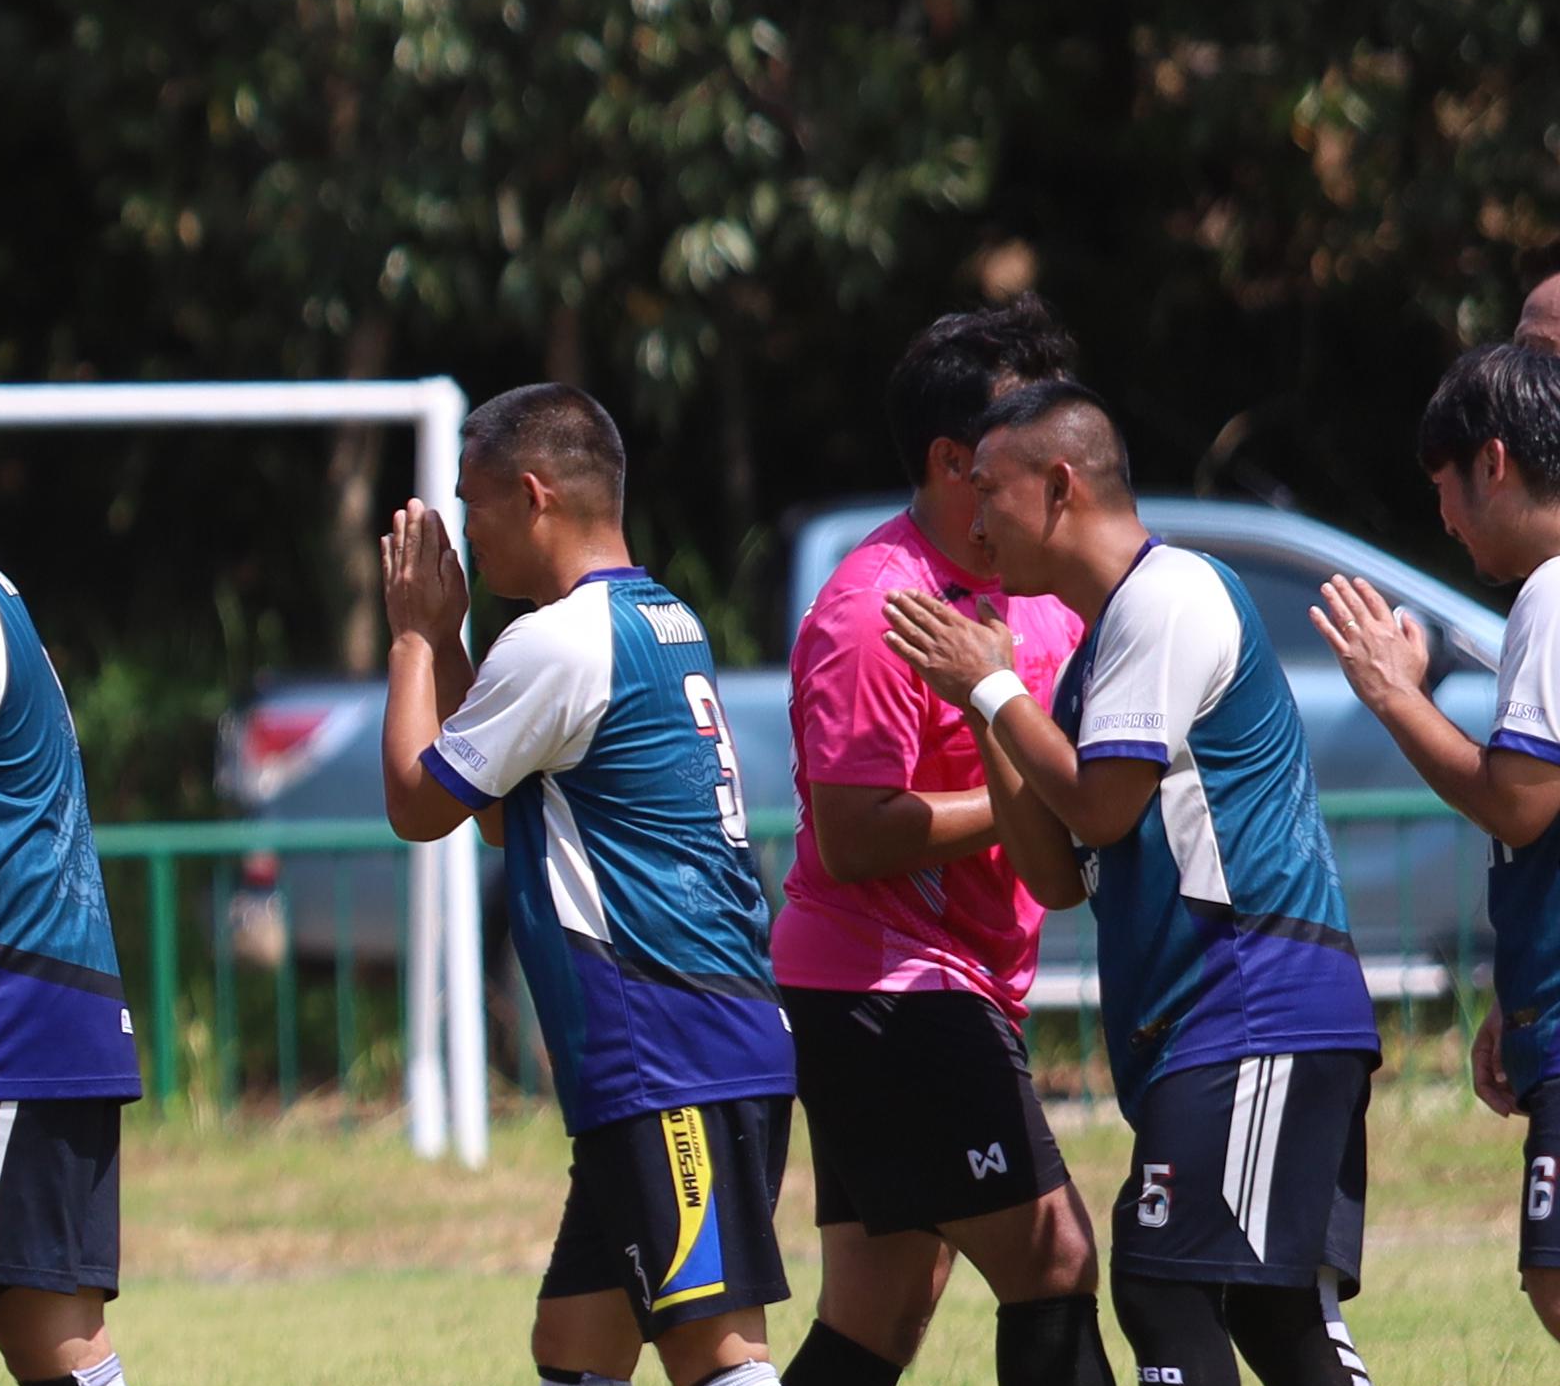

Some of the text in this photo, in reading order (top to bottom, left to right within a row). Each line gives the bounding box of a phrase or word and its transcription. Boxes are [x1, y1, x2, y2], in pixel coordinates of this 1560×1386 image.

[683, 673, 749, 848] 3
[672, 1131, 702, 1208] MAESOT
[1138, 1164, 1170, 1227] 5
